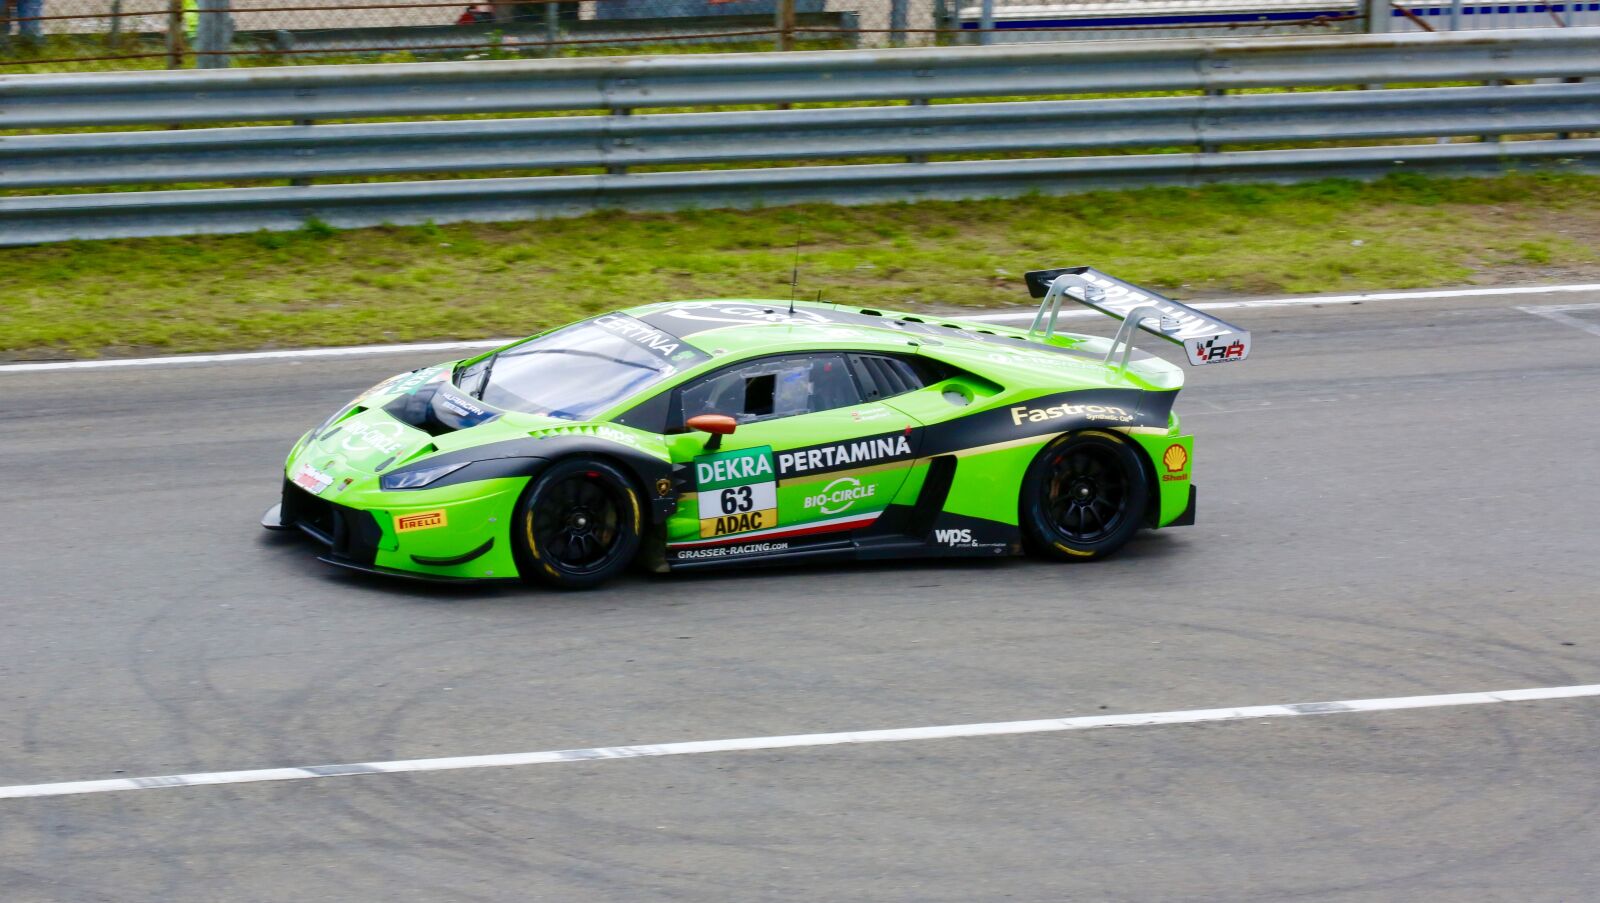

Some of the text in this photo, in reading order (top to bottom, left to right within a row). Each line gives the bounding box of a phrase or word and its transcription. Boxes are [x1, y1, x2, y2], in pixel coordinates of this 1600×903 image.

[593, 316, 680, 356] CERTINA
[1010, 403, 1127, 426] Fastron
[779, 435, 912, 474] PERTAMINA
[697, 454, 773, 485] DEKRA
[1162, 473, 1188, 482] Shell
[720, 485, 754, 515] 63
[803, 484, 876, 509] BIO-CIRCLE
[399, 512, 441, 530] PIRELLI
[714, 511, 763, 536] ADAC
[934, 528, 972, 547] wps
